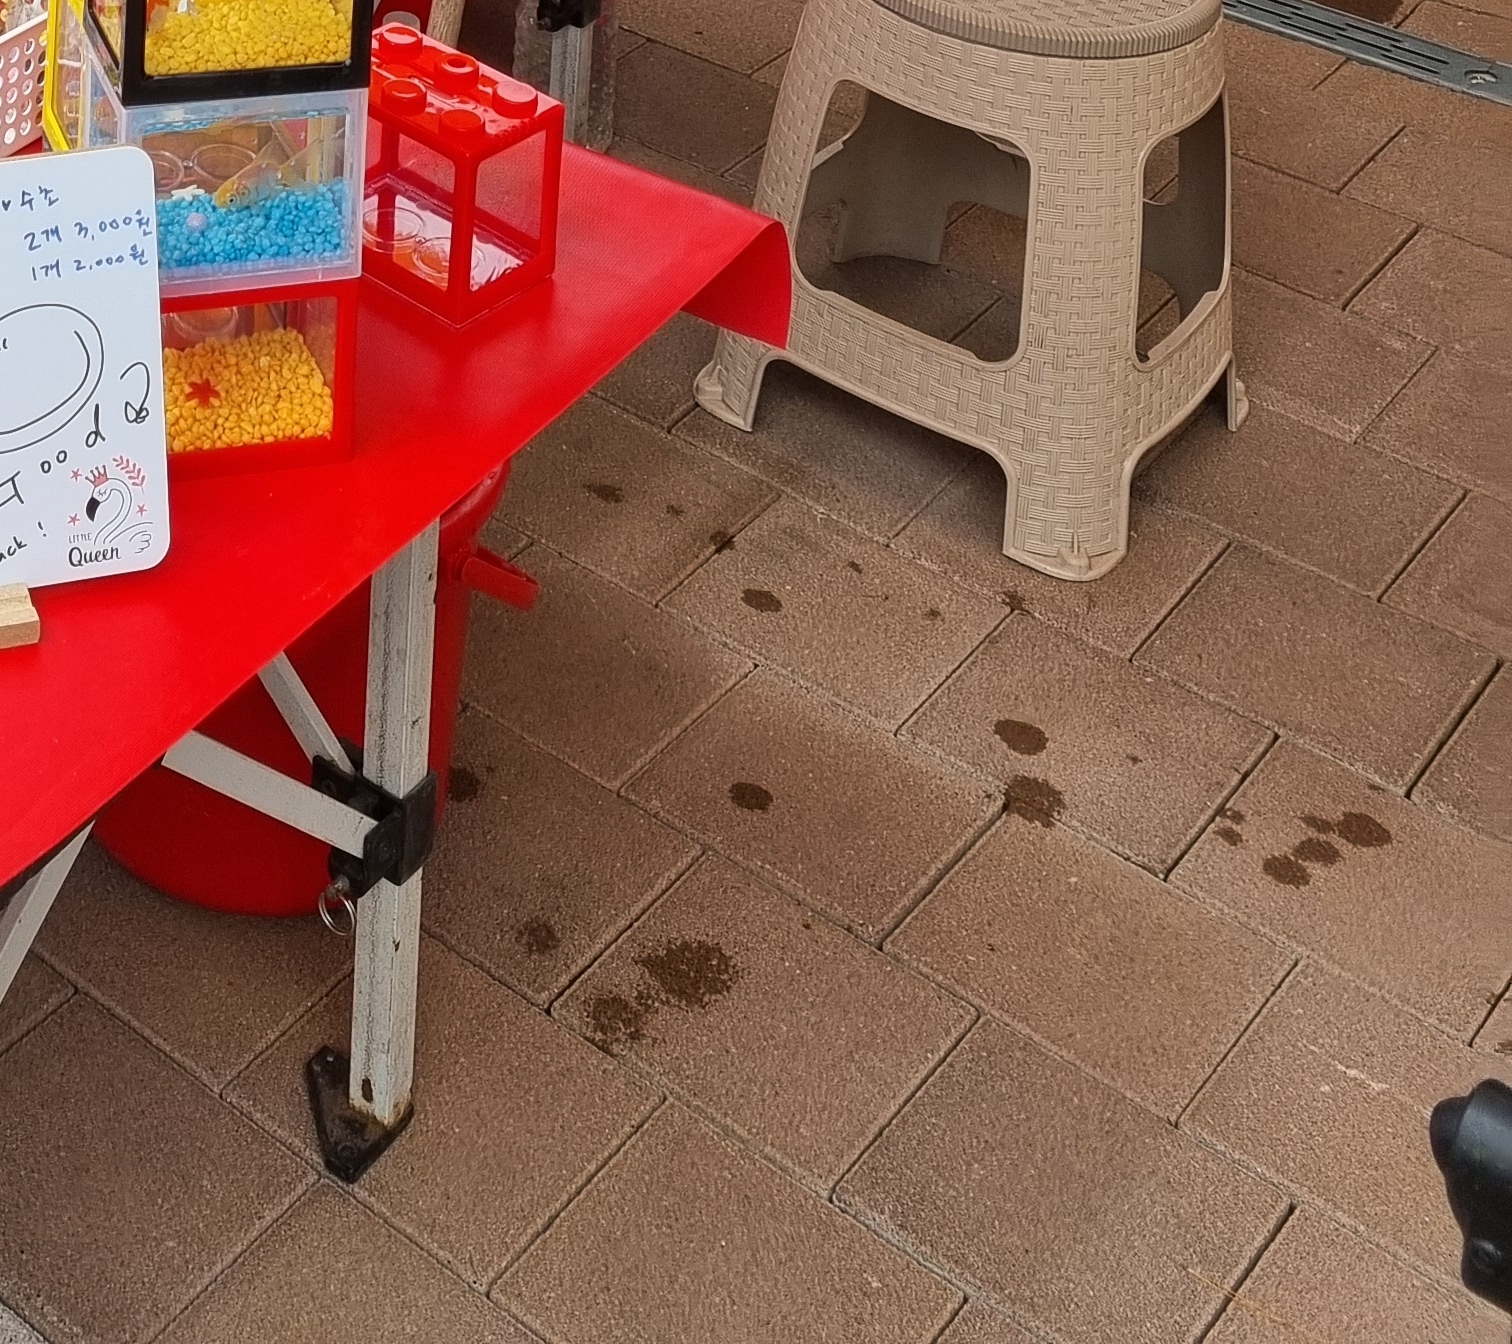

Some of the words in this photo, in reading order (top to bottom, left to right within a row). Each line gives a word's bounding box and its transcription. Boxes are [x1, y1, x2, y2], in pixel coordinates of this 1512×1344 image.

[23, 225, 63, 252] 2개
[31, 249, 62, 282] 1개
[67, 531, 93, 544] LITTLE
[67, 544, 123, 568] Queen
